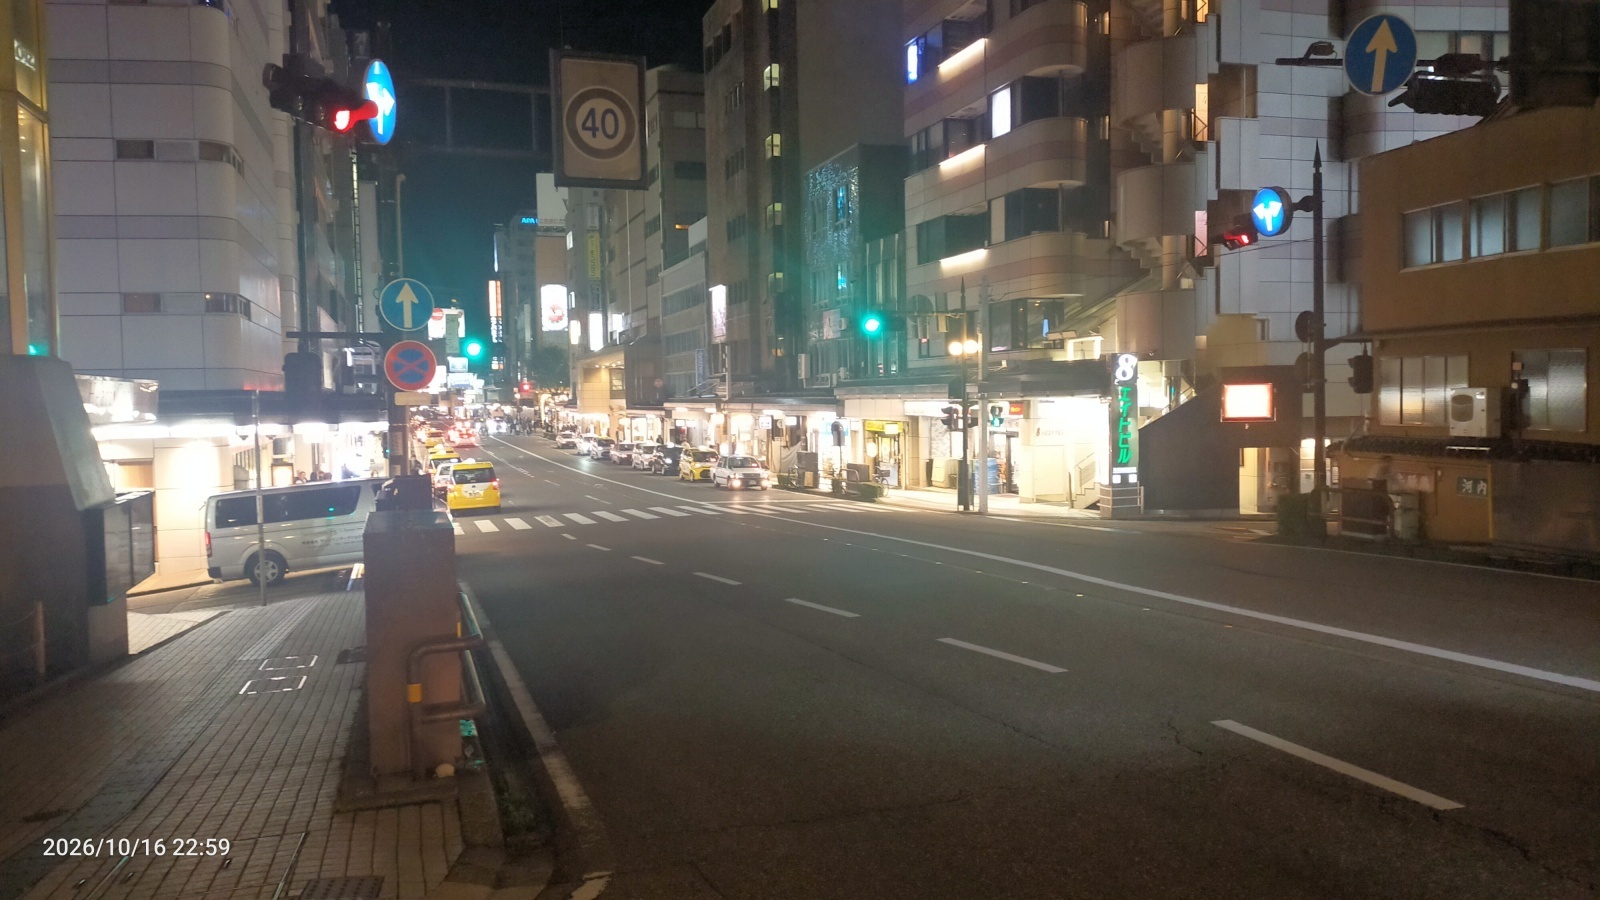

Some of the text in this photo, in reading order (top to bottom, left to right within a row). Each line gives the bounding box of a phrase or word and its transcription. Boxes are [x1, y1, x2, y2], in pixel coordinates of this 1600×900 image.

[581, 107, 619, 139] 40
[1115, 353, 1138, 381] 8
[1117, 387, 1132, 463] エイトビル
[1462, 478, 1487, 495] 河内
